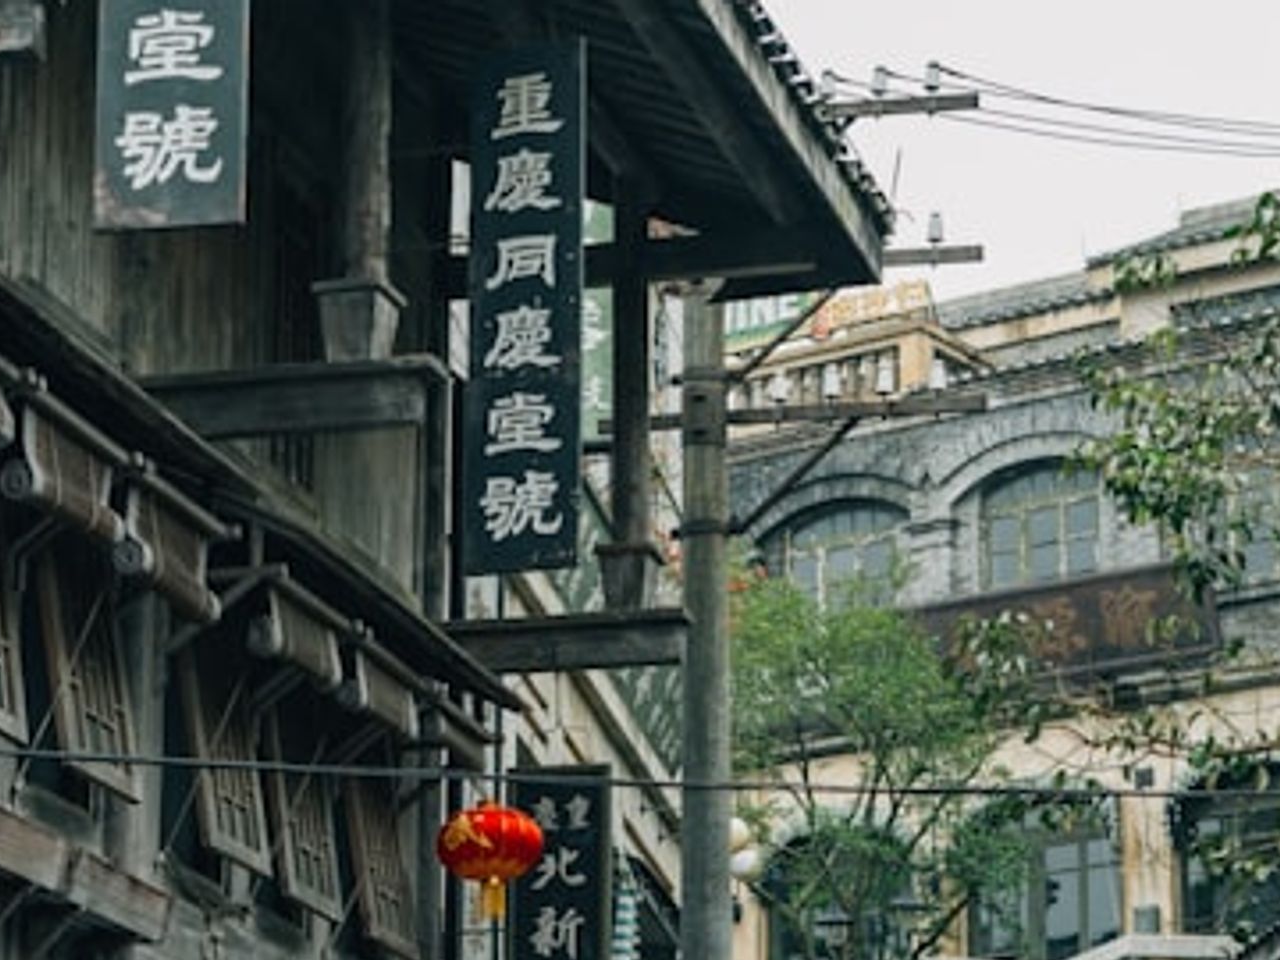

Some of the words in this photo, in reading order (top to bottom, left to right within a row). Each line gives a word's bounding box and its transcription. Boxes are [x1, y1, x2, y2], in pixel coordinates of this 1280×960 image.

[115, 9, 222, 190] 堂號
[480, 72, 565, 542] 重慶同慶堂號
